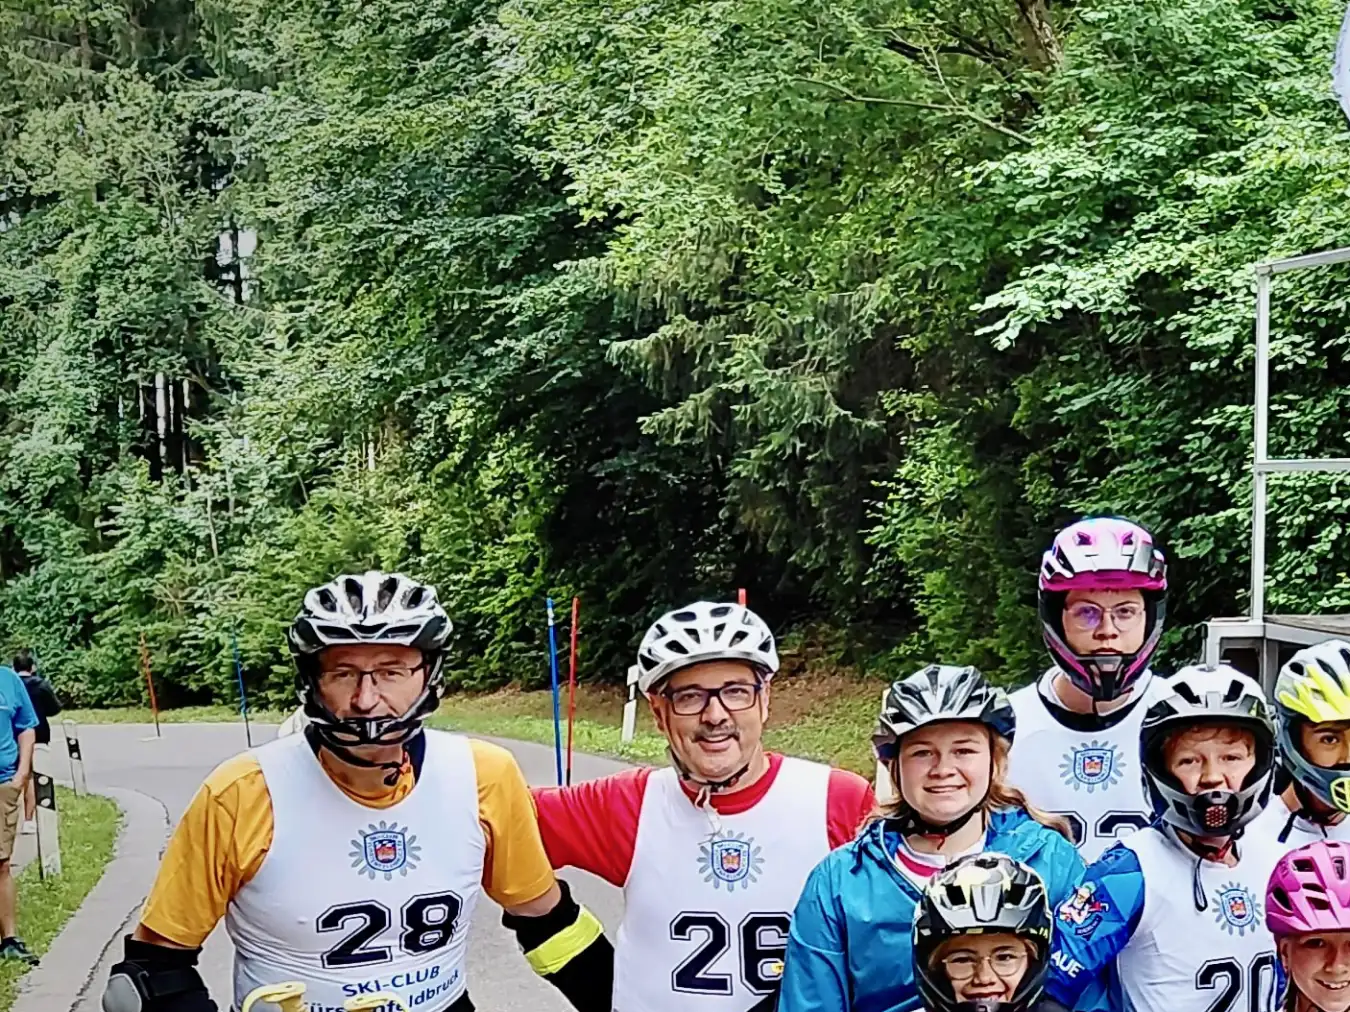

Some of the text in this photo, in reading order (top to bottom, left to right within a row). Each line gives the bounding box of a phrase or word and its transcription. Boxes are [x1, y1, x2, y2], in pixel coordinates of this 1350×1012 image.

[316, 889, 464, 970] 28
[669, 911, 792, 996] 26
[342, 965, 441, 997] SKI-CLUB
